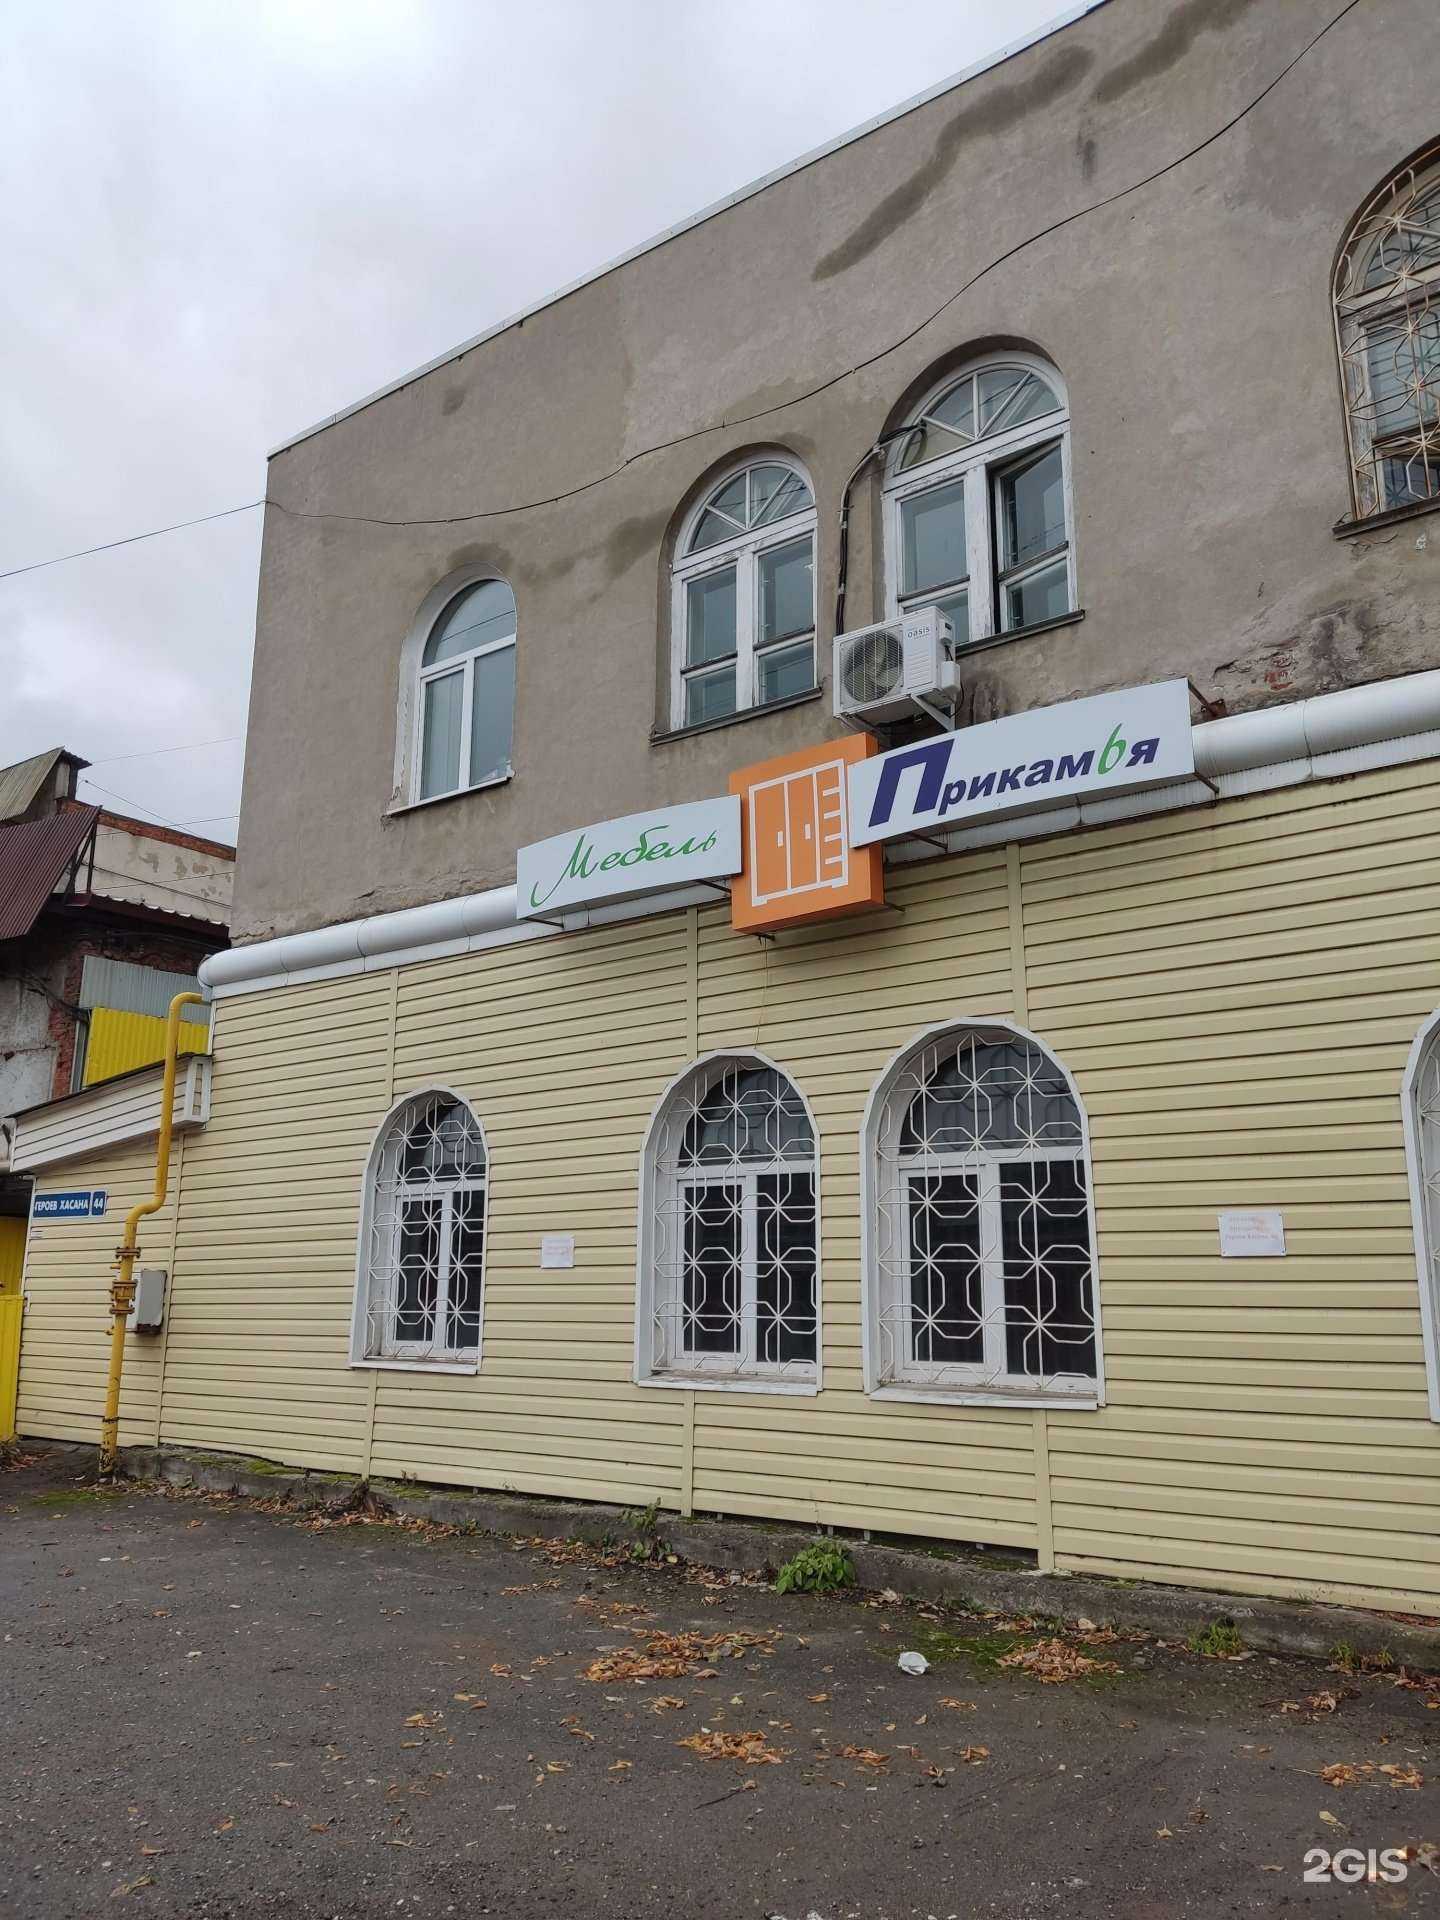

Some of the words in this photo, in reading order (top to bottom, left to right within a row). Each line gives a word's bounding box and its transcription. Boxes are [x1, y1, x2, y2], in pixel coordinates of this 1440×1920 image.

[868, 723, 1160, 828] Прикамья
[530, 824, 718, 908] Мебель
[34, 1200, 58, 1211] ГЕРОЕВ
[59, 1199, 89, 1210] ХАСАНА
[93, 1198, 103, 1209] 44
